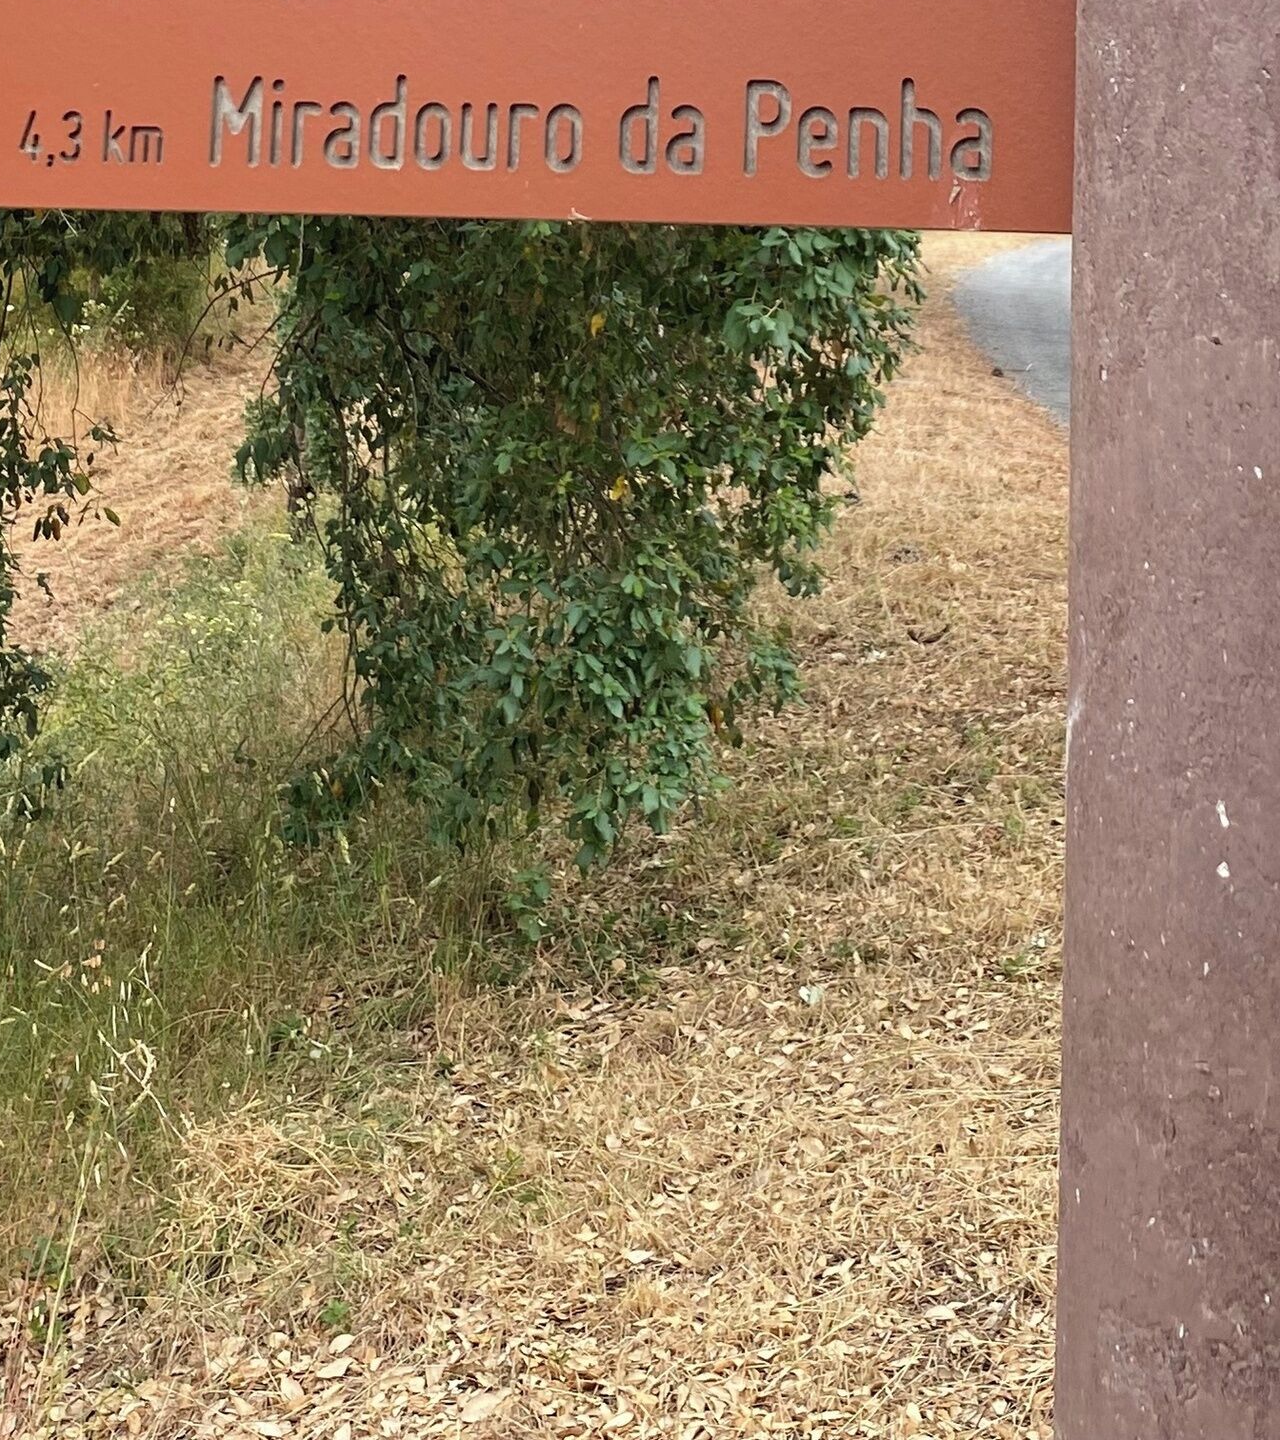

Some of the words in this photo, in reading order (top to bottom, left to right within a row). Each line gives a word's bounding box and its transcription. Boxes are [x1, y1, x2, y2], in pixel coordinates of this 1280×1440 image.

[19, 110, 83, 169] 4,3
[102, 110, 164, 165] km
[209, 74, 583, 172] Miradouro
[619, 75, 706, 176] da
[743, 76, 994, 182] Penha
